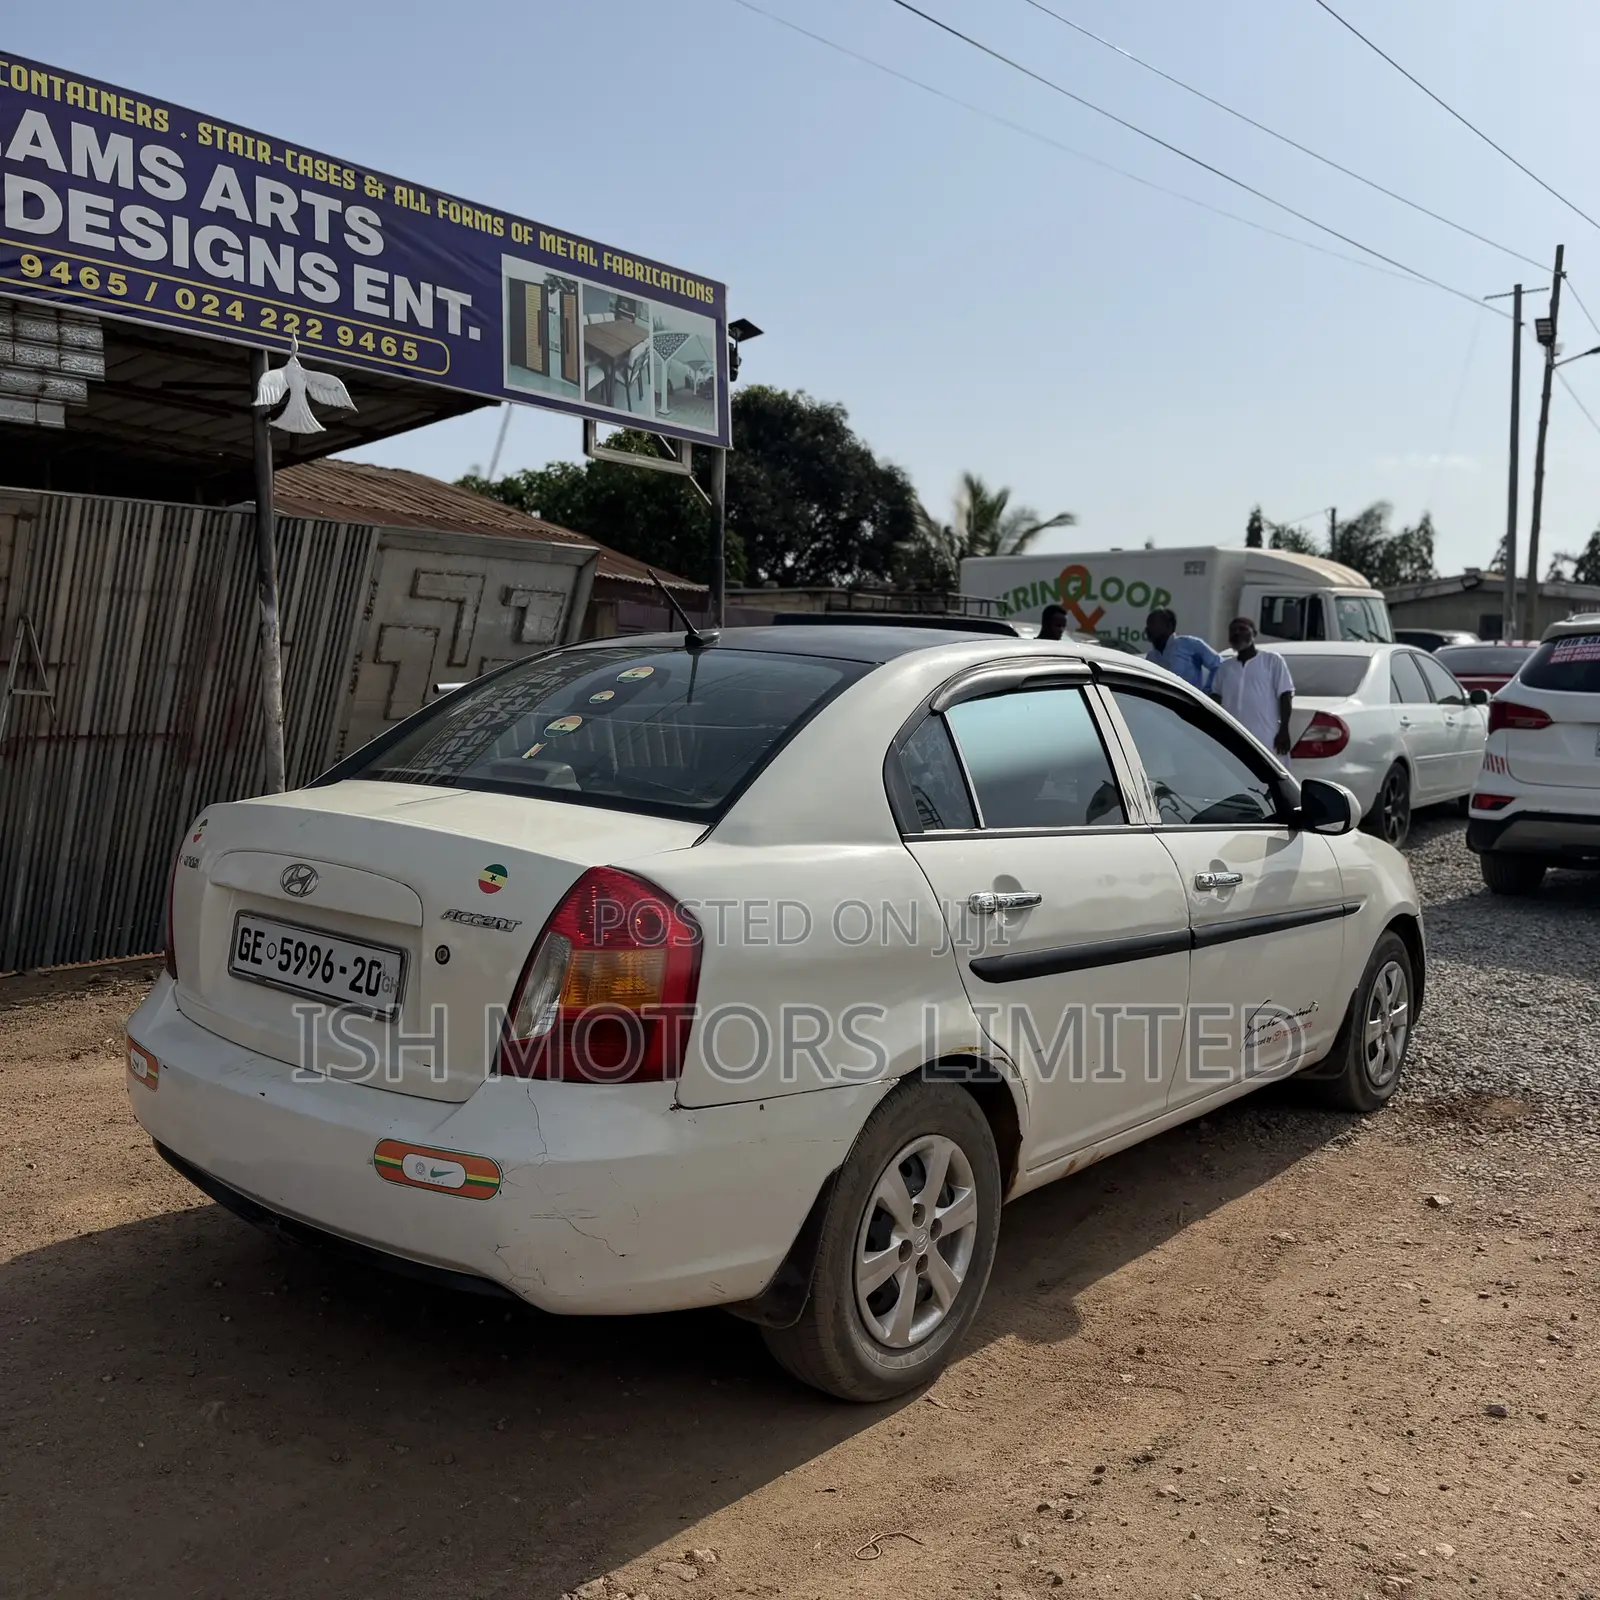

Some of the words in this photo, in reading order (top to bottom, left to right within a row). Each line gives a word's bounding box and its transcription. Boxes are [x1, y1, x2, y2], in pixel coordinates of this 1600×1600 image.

[0, 109, 188, 201] AMS
[200, 163, 385, 256] ARTS
[198, 122, 357, 192] STAIR-CASES
[364, 175, 387, 200] &
[394, 185, 431, 214] ALL
[436, 199, 504, 237] FORMS
[511, 222, 534, 246] OF
[539, 231, 598, 268] METAL
[603, 252, 714, 304] FABRICATIONS
[4, 172, 341, 304] DESIGNS
[353, 264, 481, 341] ENT.
[20, 254, 128, 297] 9465
[144, 281, 158, 302] /
[175, 287, 245, 323] 024
[260, 307, 323, 341] 222
[337, 325, 419, 362] 9465
[1581, 635, 1600, 646] SA
[237, 927, 265, 965] GE
[277, 937, 382, 997] 5996-20
